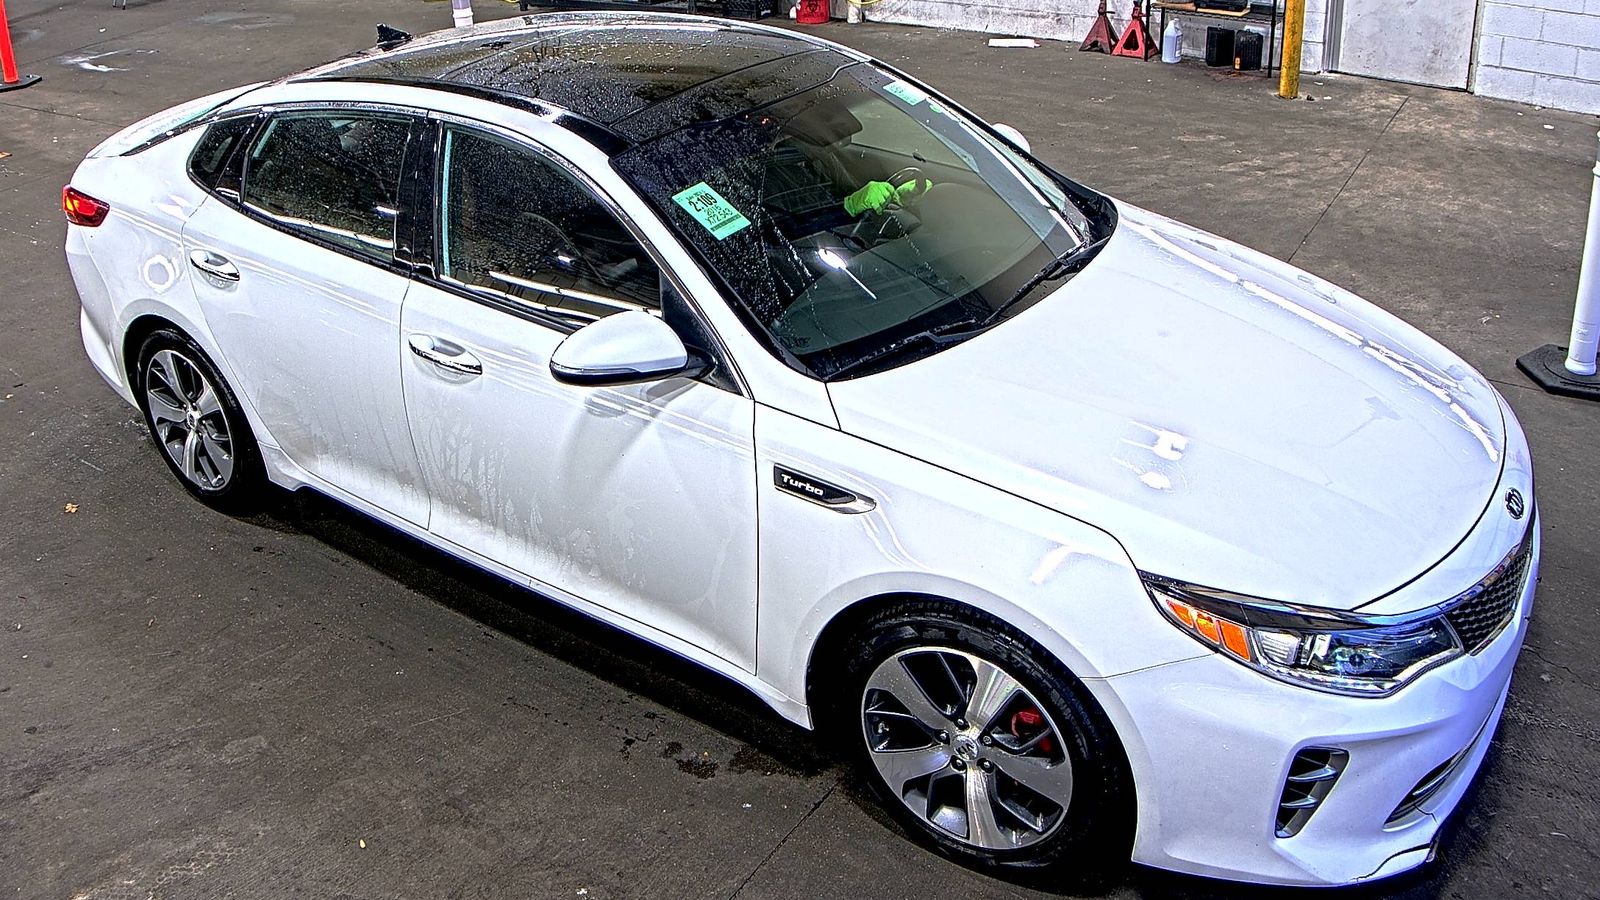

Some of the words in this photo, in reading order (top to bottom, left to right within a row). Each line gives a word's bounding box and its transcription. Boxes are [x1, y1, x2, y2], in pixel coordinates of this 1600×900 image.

[688, 193, 717, 212] 2:109
[781, 473, 824, 496] Turbo
[955, 742, 974, 755] KIA
